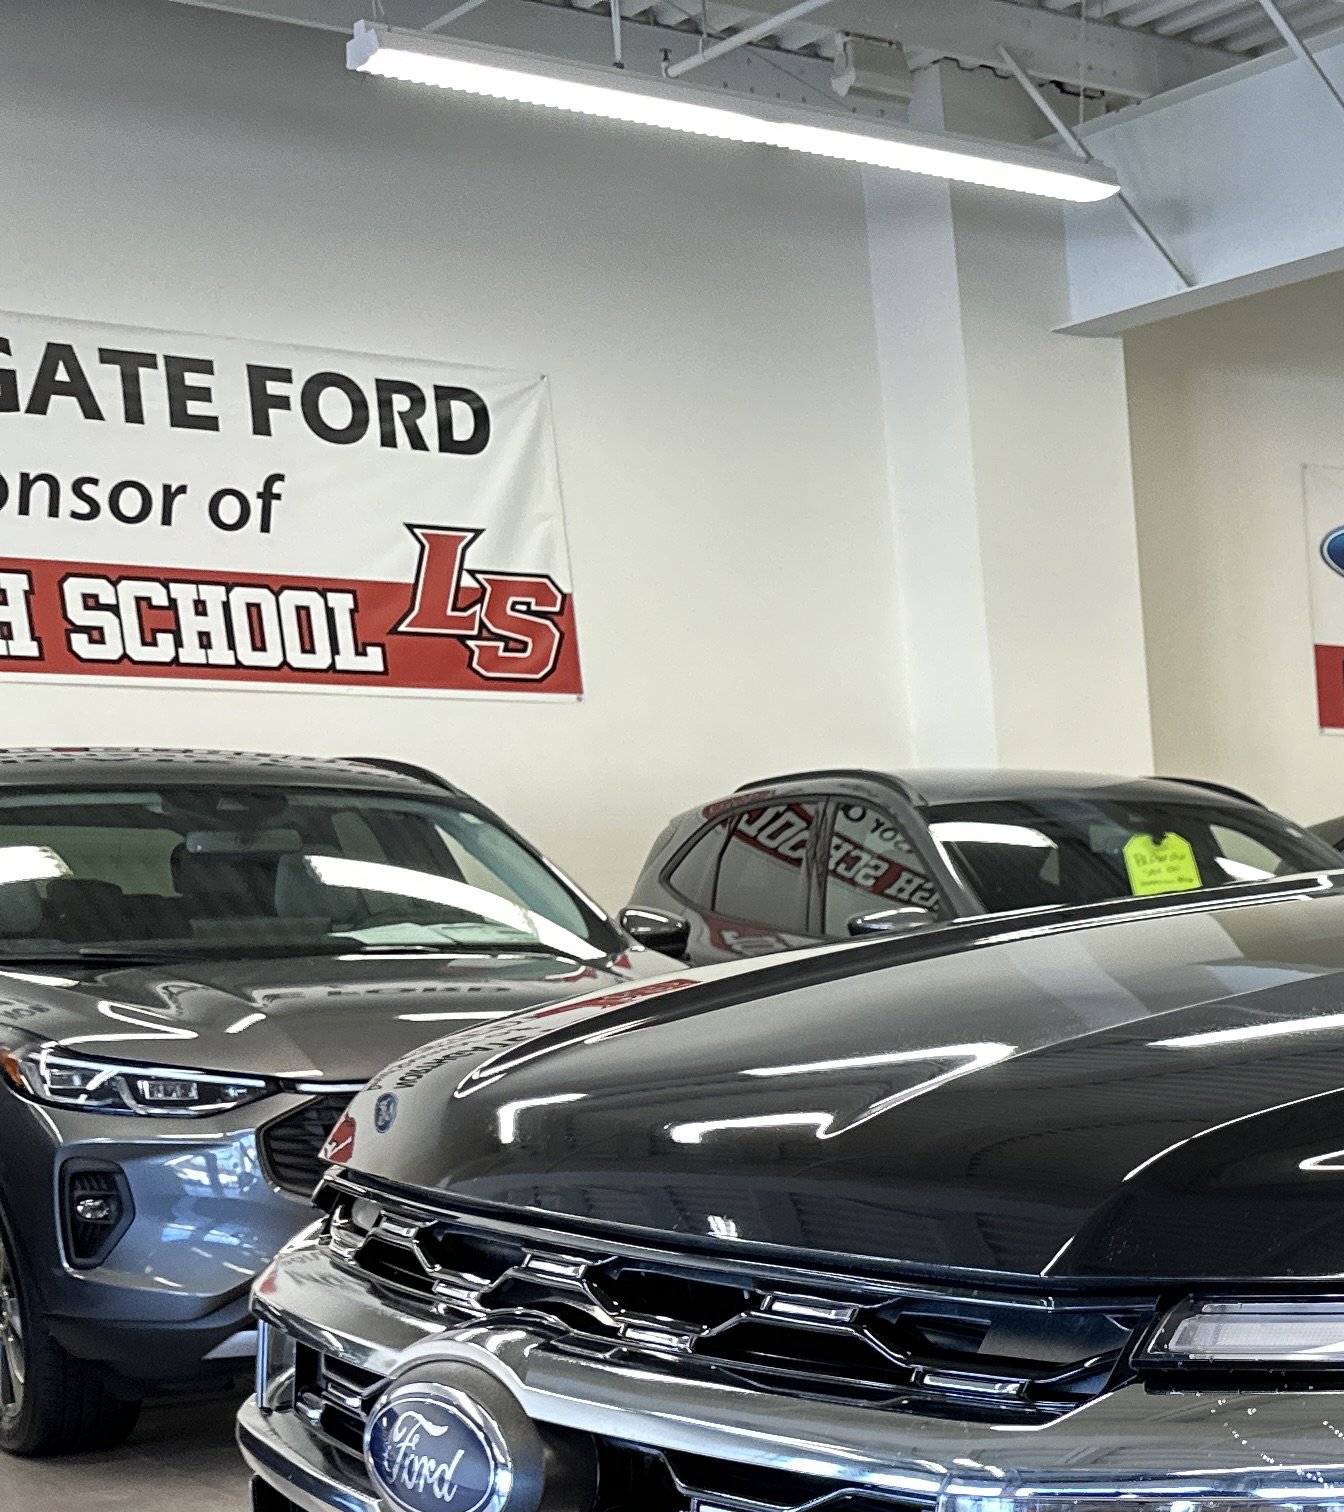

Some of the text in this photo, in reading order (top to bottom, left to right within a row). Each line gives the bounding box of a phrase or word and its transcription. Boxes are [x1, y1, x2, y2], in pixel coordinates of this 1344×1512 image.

[245, 362, 491, 455] FORD
[0, 471, 286, 534] nsor of
[58, 572, 389, 676] SCHOOL
[383, 1410, 465, 1502] Ford
